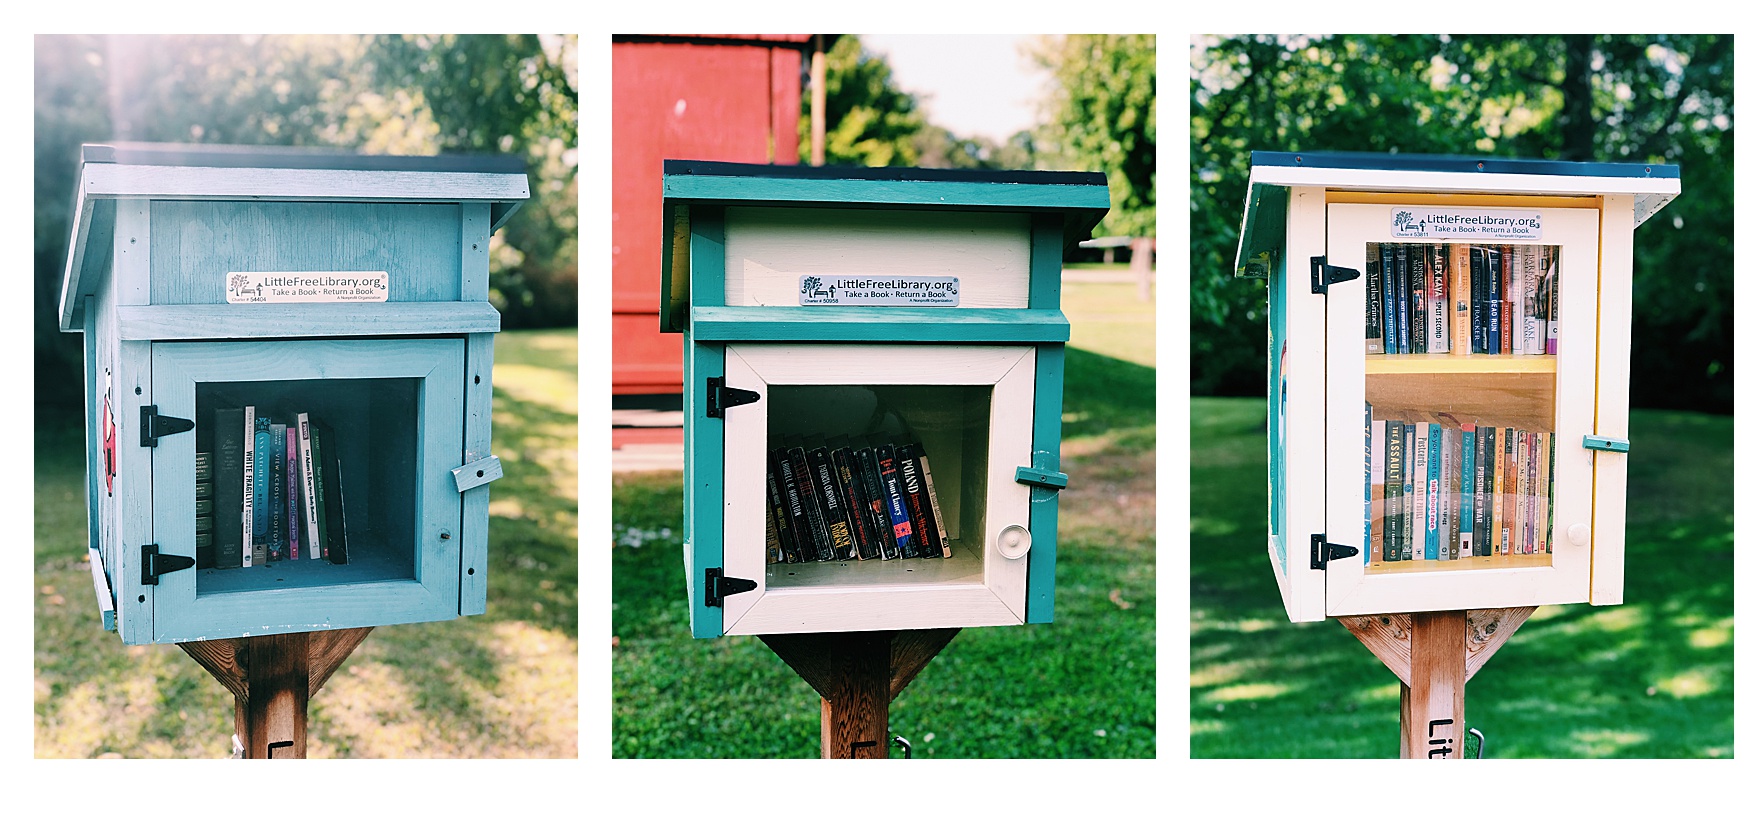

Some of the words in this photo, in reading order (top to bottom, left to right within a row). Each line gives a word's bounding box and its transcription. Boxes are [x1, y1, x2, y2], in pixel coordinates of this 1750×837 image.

[1427, 214, 1536, 228] LittleFreeLibrary.org
[1434, 254, 1442, 274] ALEX
[265, 276, 380, 288] LittleFreeLibrary.org
[272, 288, 290, 296] Take
[298, 288, 318, 296] Book
[836, 279, 952, 291] LittleFreeLibrary.org
[1370, 273, 1378, 300] Martha
[1434, 277, 1442, 297] KAVA
[870, 290, 890, 298] Book
[928, 290, 946, 298] Book
[1371, 300, 1379, 327] Grimes
[1432, 429, 1438, 439] So
[1418, 437, 1427, 467] Postcards
[1430, 440, 1438, 450] you
[1390, 439, 1400, 480] ASSAULT
[888, 478, 896, 493] Tom
[901, 459, 919, 494] POLAND
[1476, 466, 1484, 500] PRISONER
[891, 493, 902, 516] Clancy
